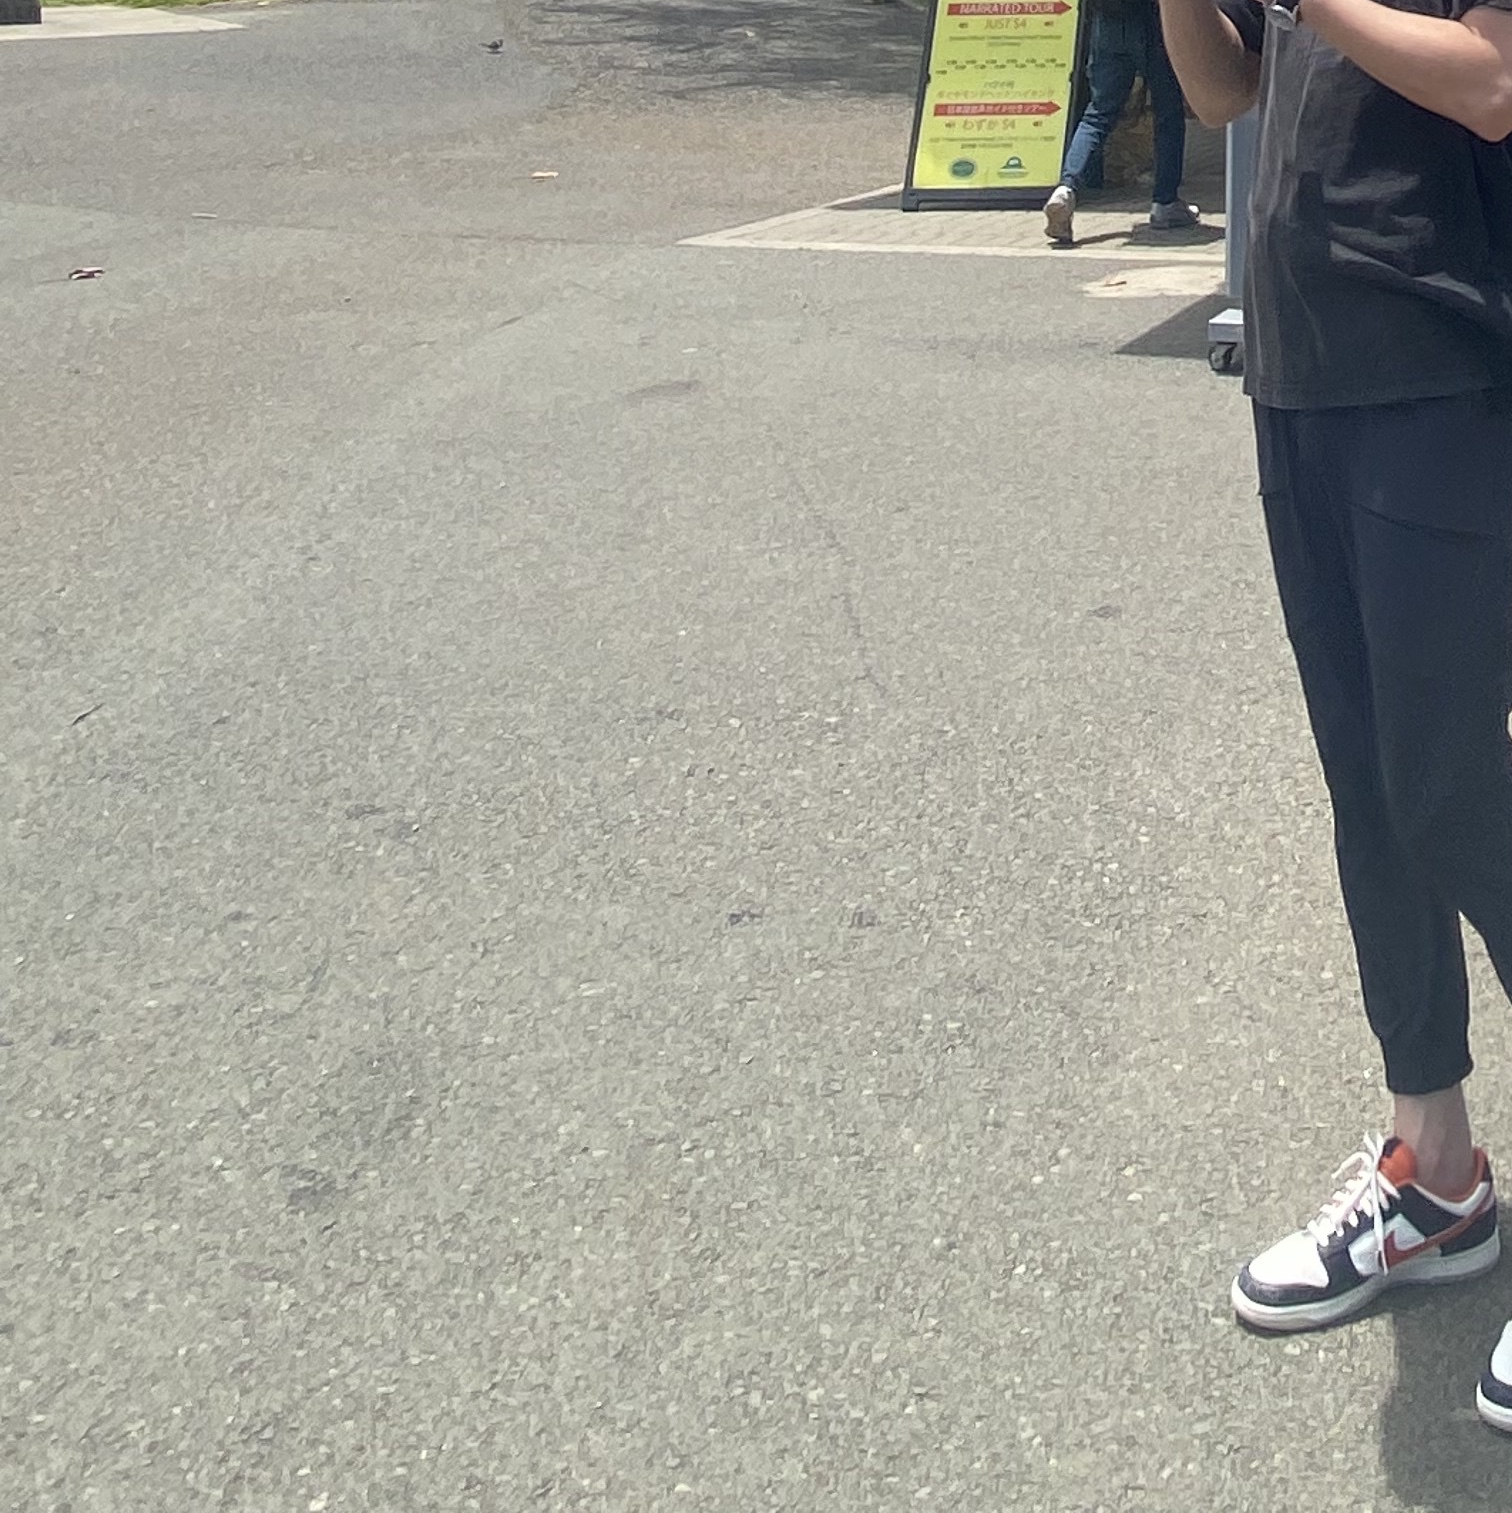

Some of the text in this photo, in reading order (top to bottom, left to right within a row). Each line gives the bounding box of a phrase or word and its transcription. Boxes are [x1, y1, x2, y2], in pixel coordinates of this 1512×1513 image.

[959, 2, 1055, 15] NARRATED TOUR
[985, 19, 1009, 29] JUST
